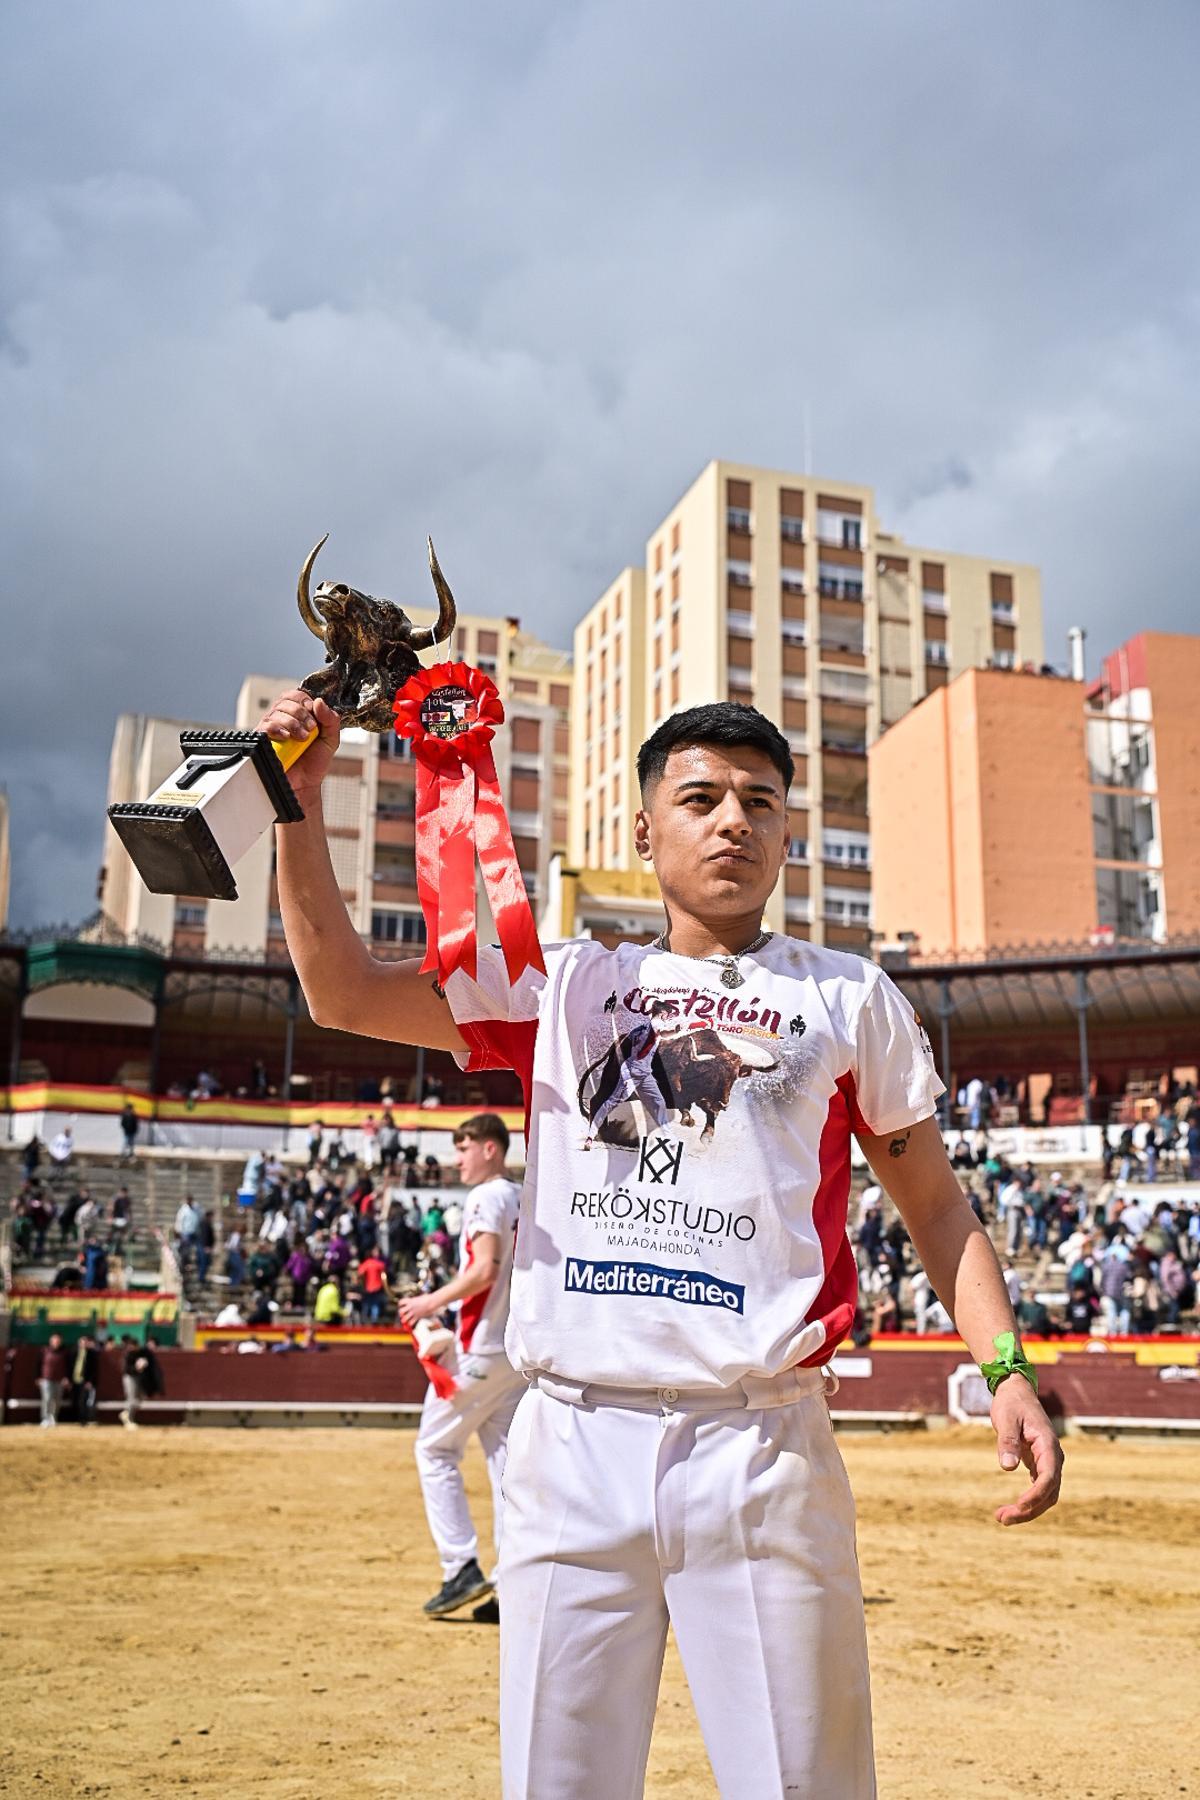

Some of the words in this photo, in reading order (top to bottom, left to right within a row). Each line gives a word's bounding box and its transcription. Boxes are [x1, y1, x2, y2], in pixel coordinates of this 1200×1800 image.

[607, 1235, 701, 1257] MAJADAHONDA
[644, 1227, 659, 1235] DE
[667, 1229, 723, 1248] COCINAS
[567, 1261, 739, 1308] Mediterráneo
